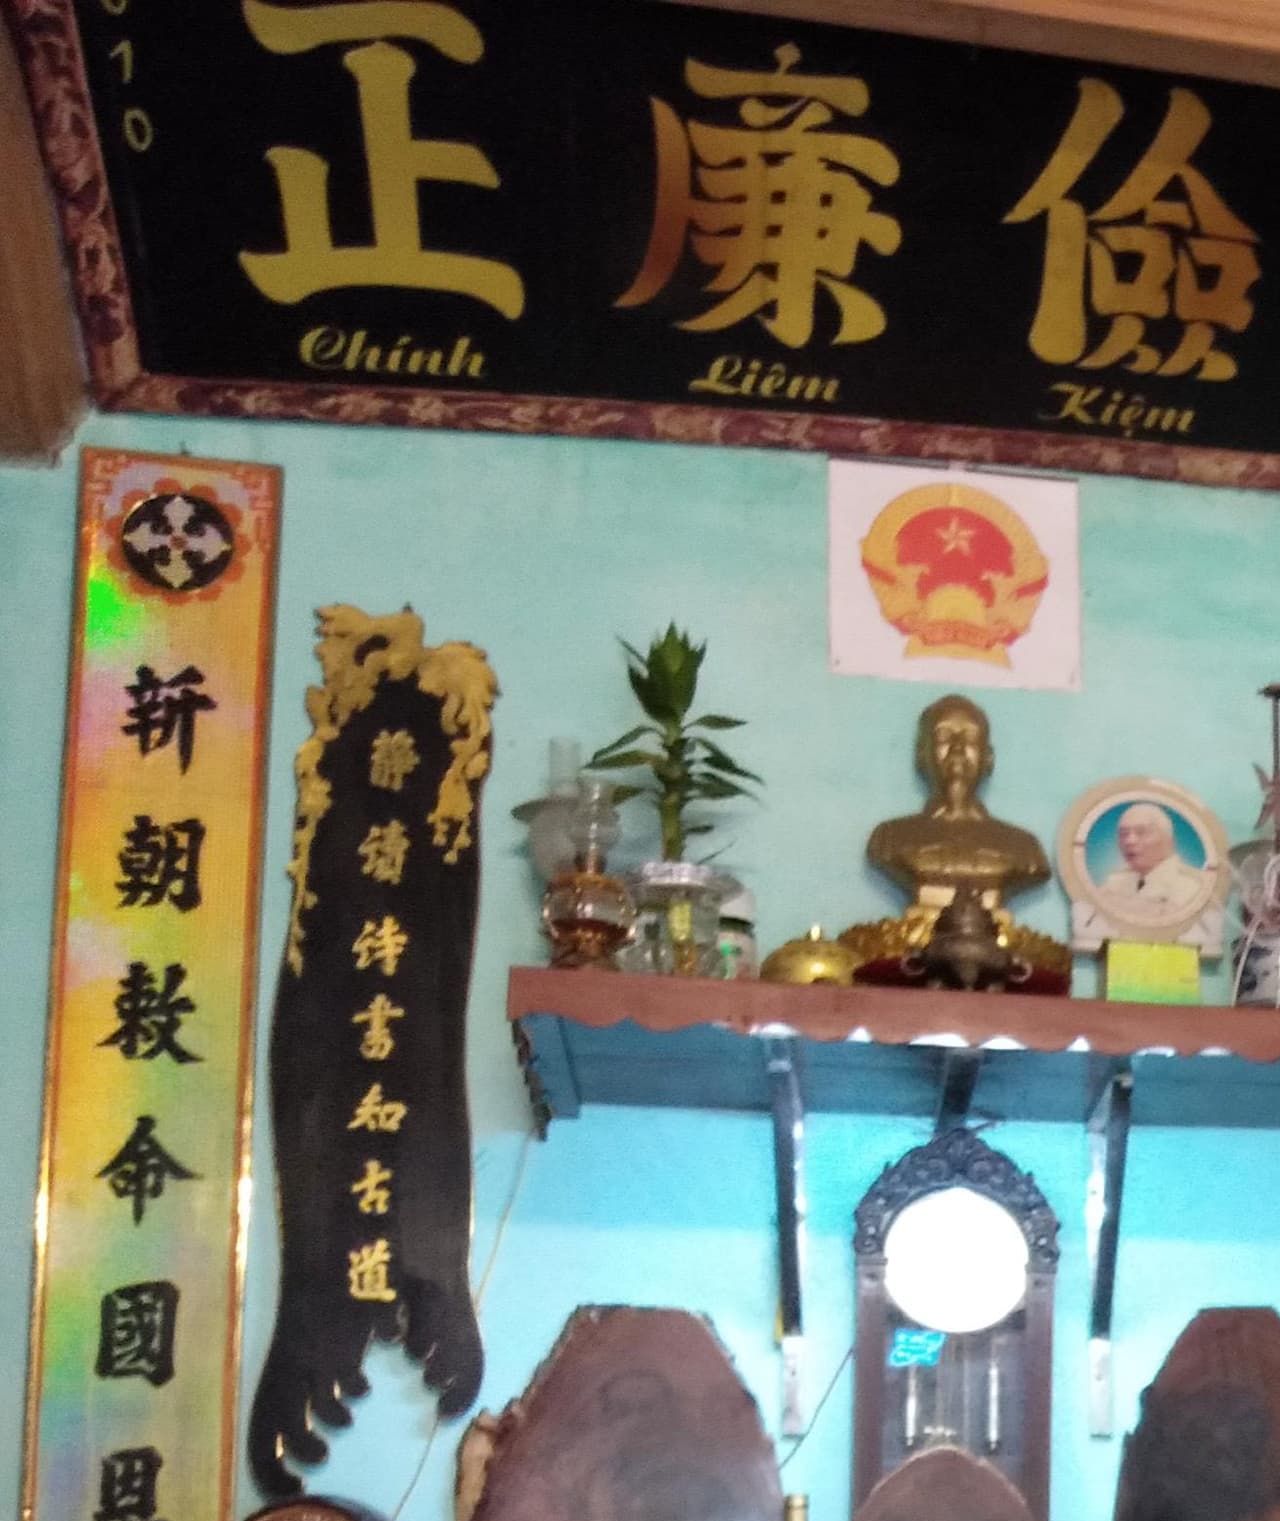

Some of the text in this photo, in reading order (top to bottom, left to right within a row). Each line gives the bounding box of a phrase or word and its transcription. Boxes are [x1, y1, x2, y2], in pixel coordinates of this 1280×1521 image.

[239, 0, 525, 320] 正
[614, 42, 902, 348] 廉
[298, 322, 488, 379] Chính
[688, 353, 841, 403] Liêm
[1036, 381, 1196, 439] Kiệm
